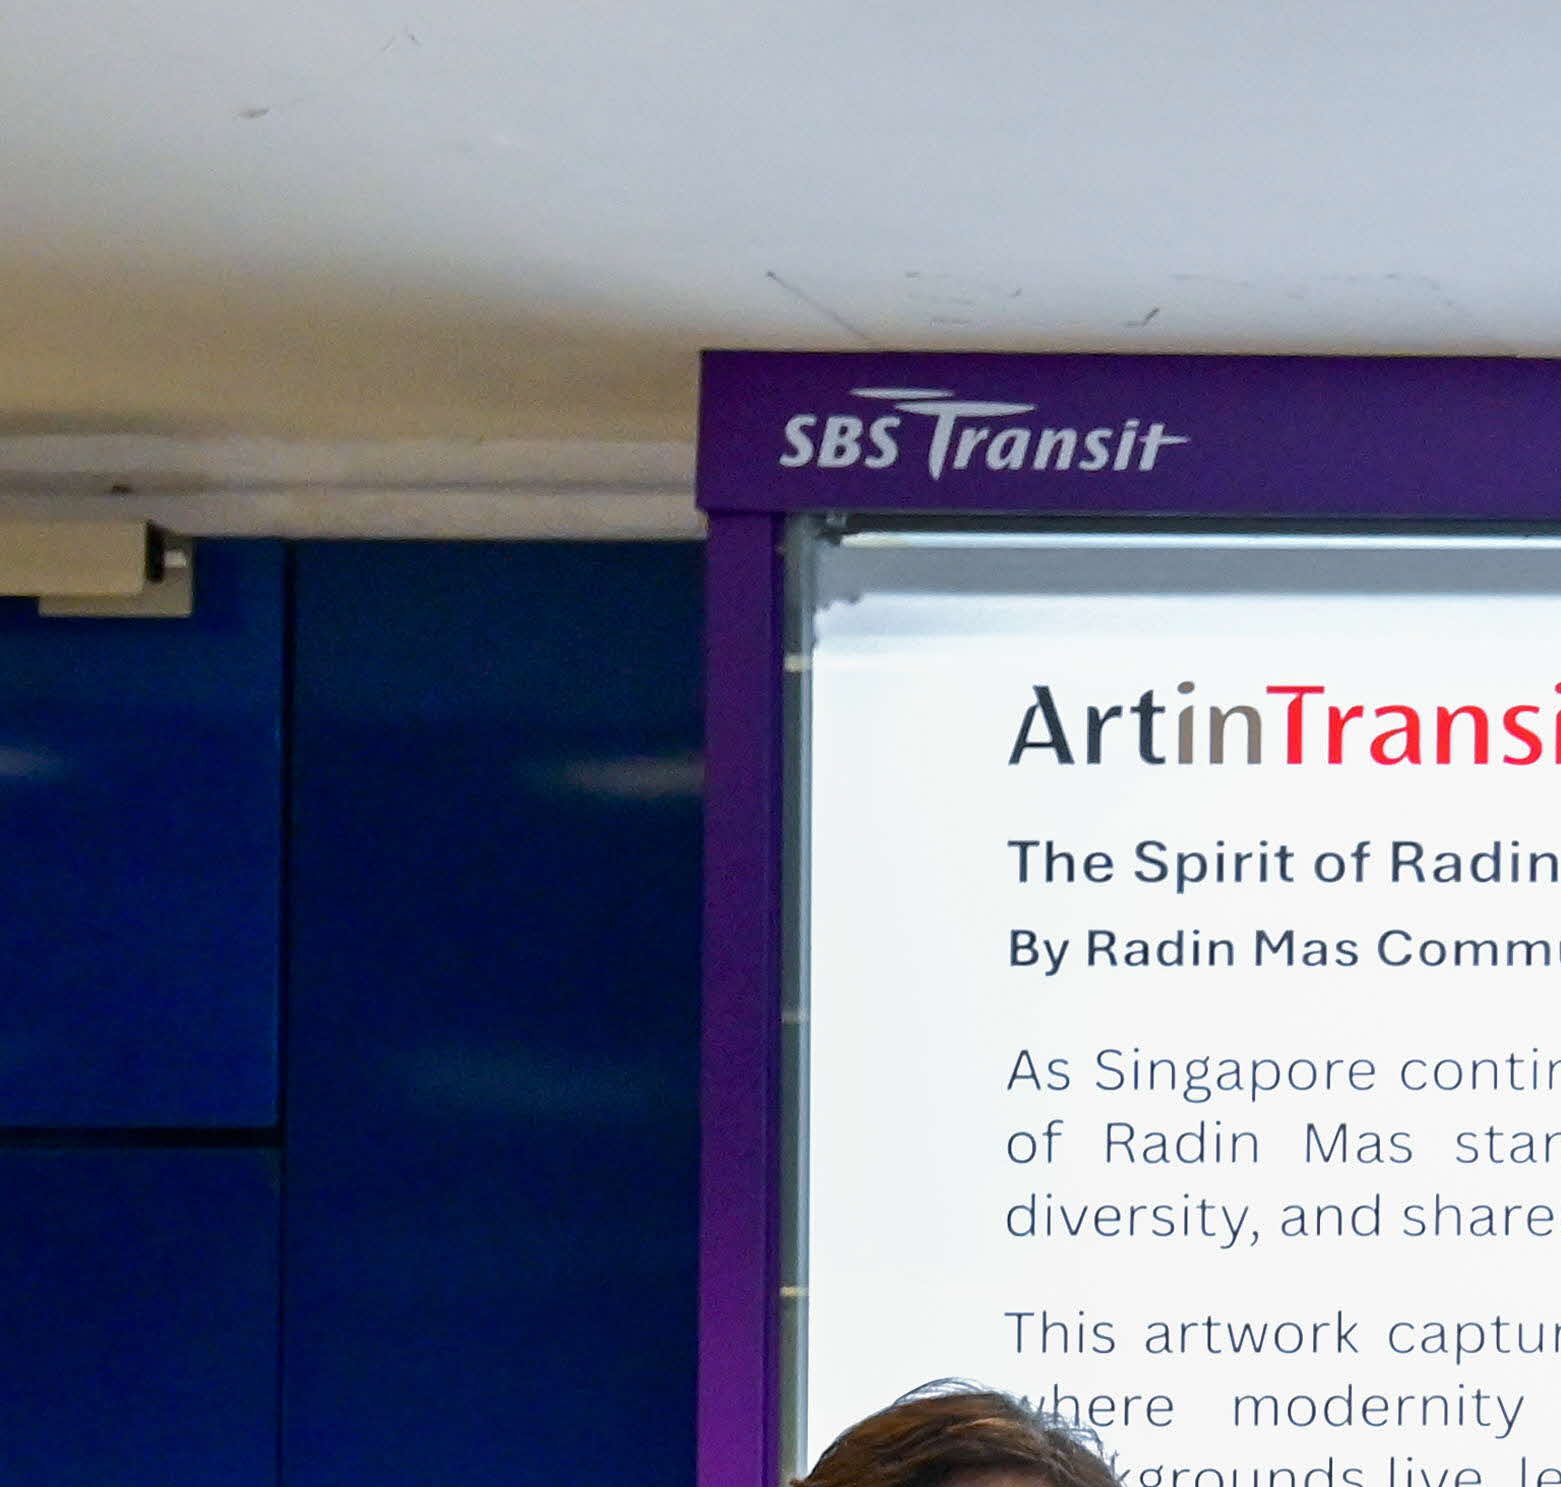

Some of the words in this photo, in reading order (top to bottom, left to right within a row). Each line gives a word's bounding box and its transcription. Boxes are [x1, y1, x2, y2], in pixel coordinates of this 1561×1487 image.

[780, 415, 901, 468] SBS
[895, 399, 1190, 481] Transit
[1006, 839, 1114, 884] The
[1134, 839, 1295, 895] Spirit
[1313, 840, 1371, 884] of
[1391, 839, 1559, 884] Radin
[1009, 928, 1070, 977] By
[1087, 928, 1235, 968] Radin
[1254, 929, 1359, 967] Mas
[1006, 1048, 1071, 1092] As
[1095, 1047, 1376, 1105] Singapore
[1006, 1118, 1065, 1165] of
[1106, 1119, 1259, 1165] Radin
[1305, 1122, 1413, 1169] Mas
[1006, 1192, 1260, 1250] diversity,
[1280, 1192, 1381, 1238] and
[1003, 1309, 1116, 1355] This
[1145, 1309, 1359, 1355] artwork
[1233, 1383, 1525, 1440] modernity
